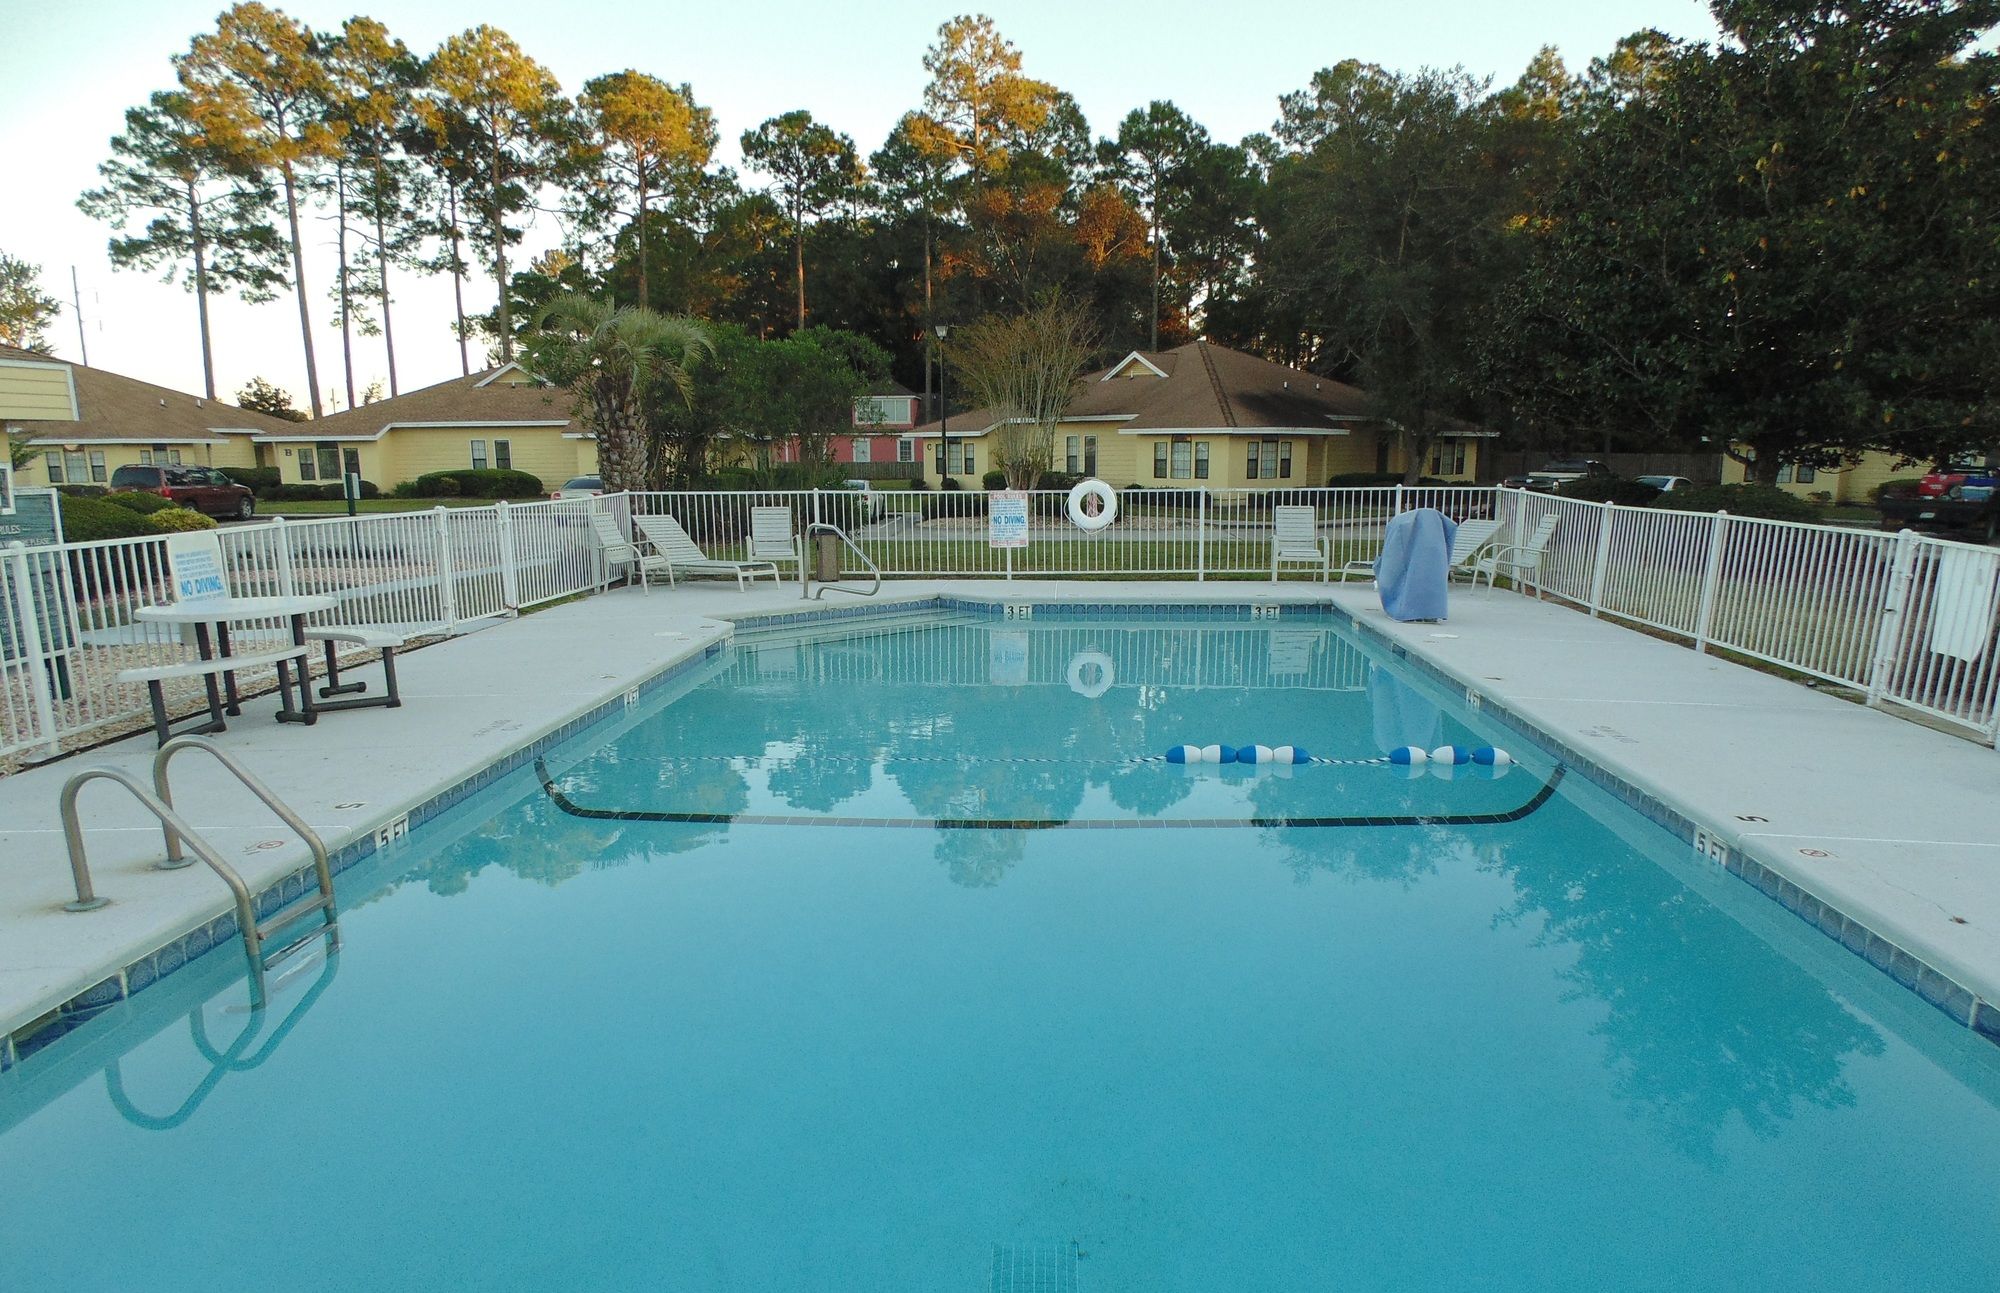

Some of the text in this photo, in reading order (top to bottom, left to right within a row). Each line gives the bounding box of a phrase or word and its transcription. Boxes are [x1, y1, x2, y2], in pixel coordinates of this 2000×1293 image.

[285, 448, 292, 456] B
[993, 515, 1002, 524] NO
[181, 580, 193, 597] NO
[1007, 605, 1014, 618] 3
[1255, 606, 1261, 618] 3
[380, 817, 407, 847] 5 FT
[1697, 831, 1725, 864] 5 FT
